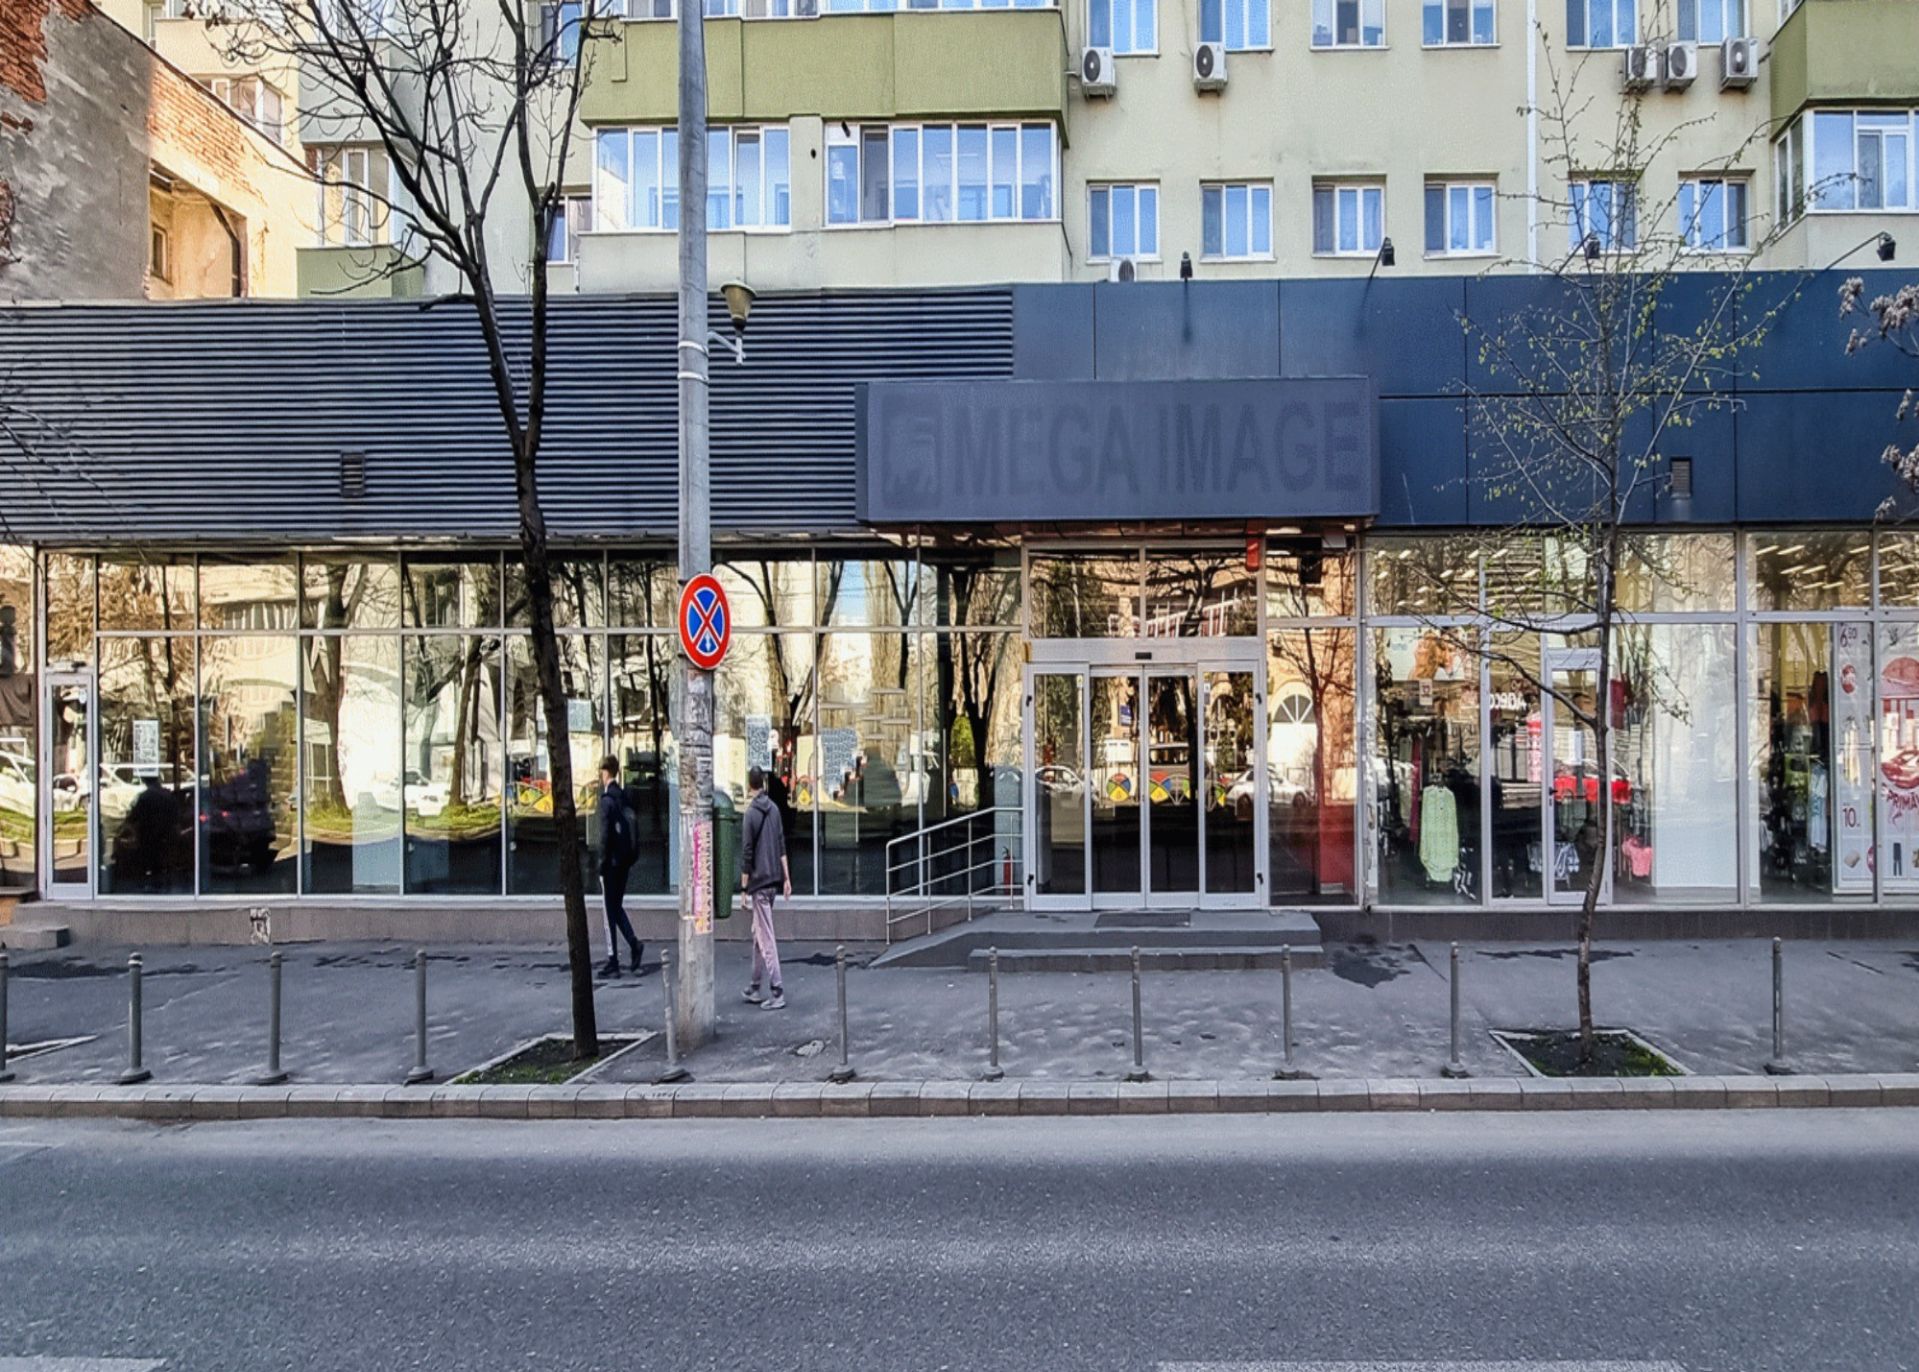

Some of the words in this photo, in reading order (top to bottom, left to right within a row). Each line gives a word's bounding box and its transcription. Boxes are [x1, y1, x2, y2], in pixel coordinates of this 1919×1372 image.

[953, 403, 1141, 497] MEGA
[1157, 399, 1362, 495] IMAGE
[1842, 807, 1856, 828] 10
